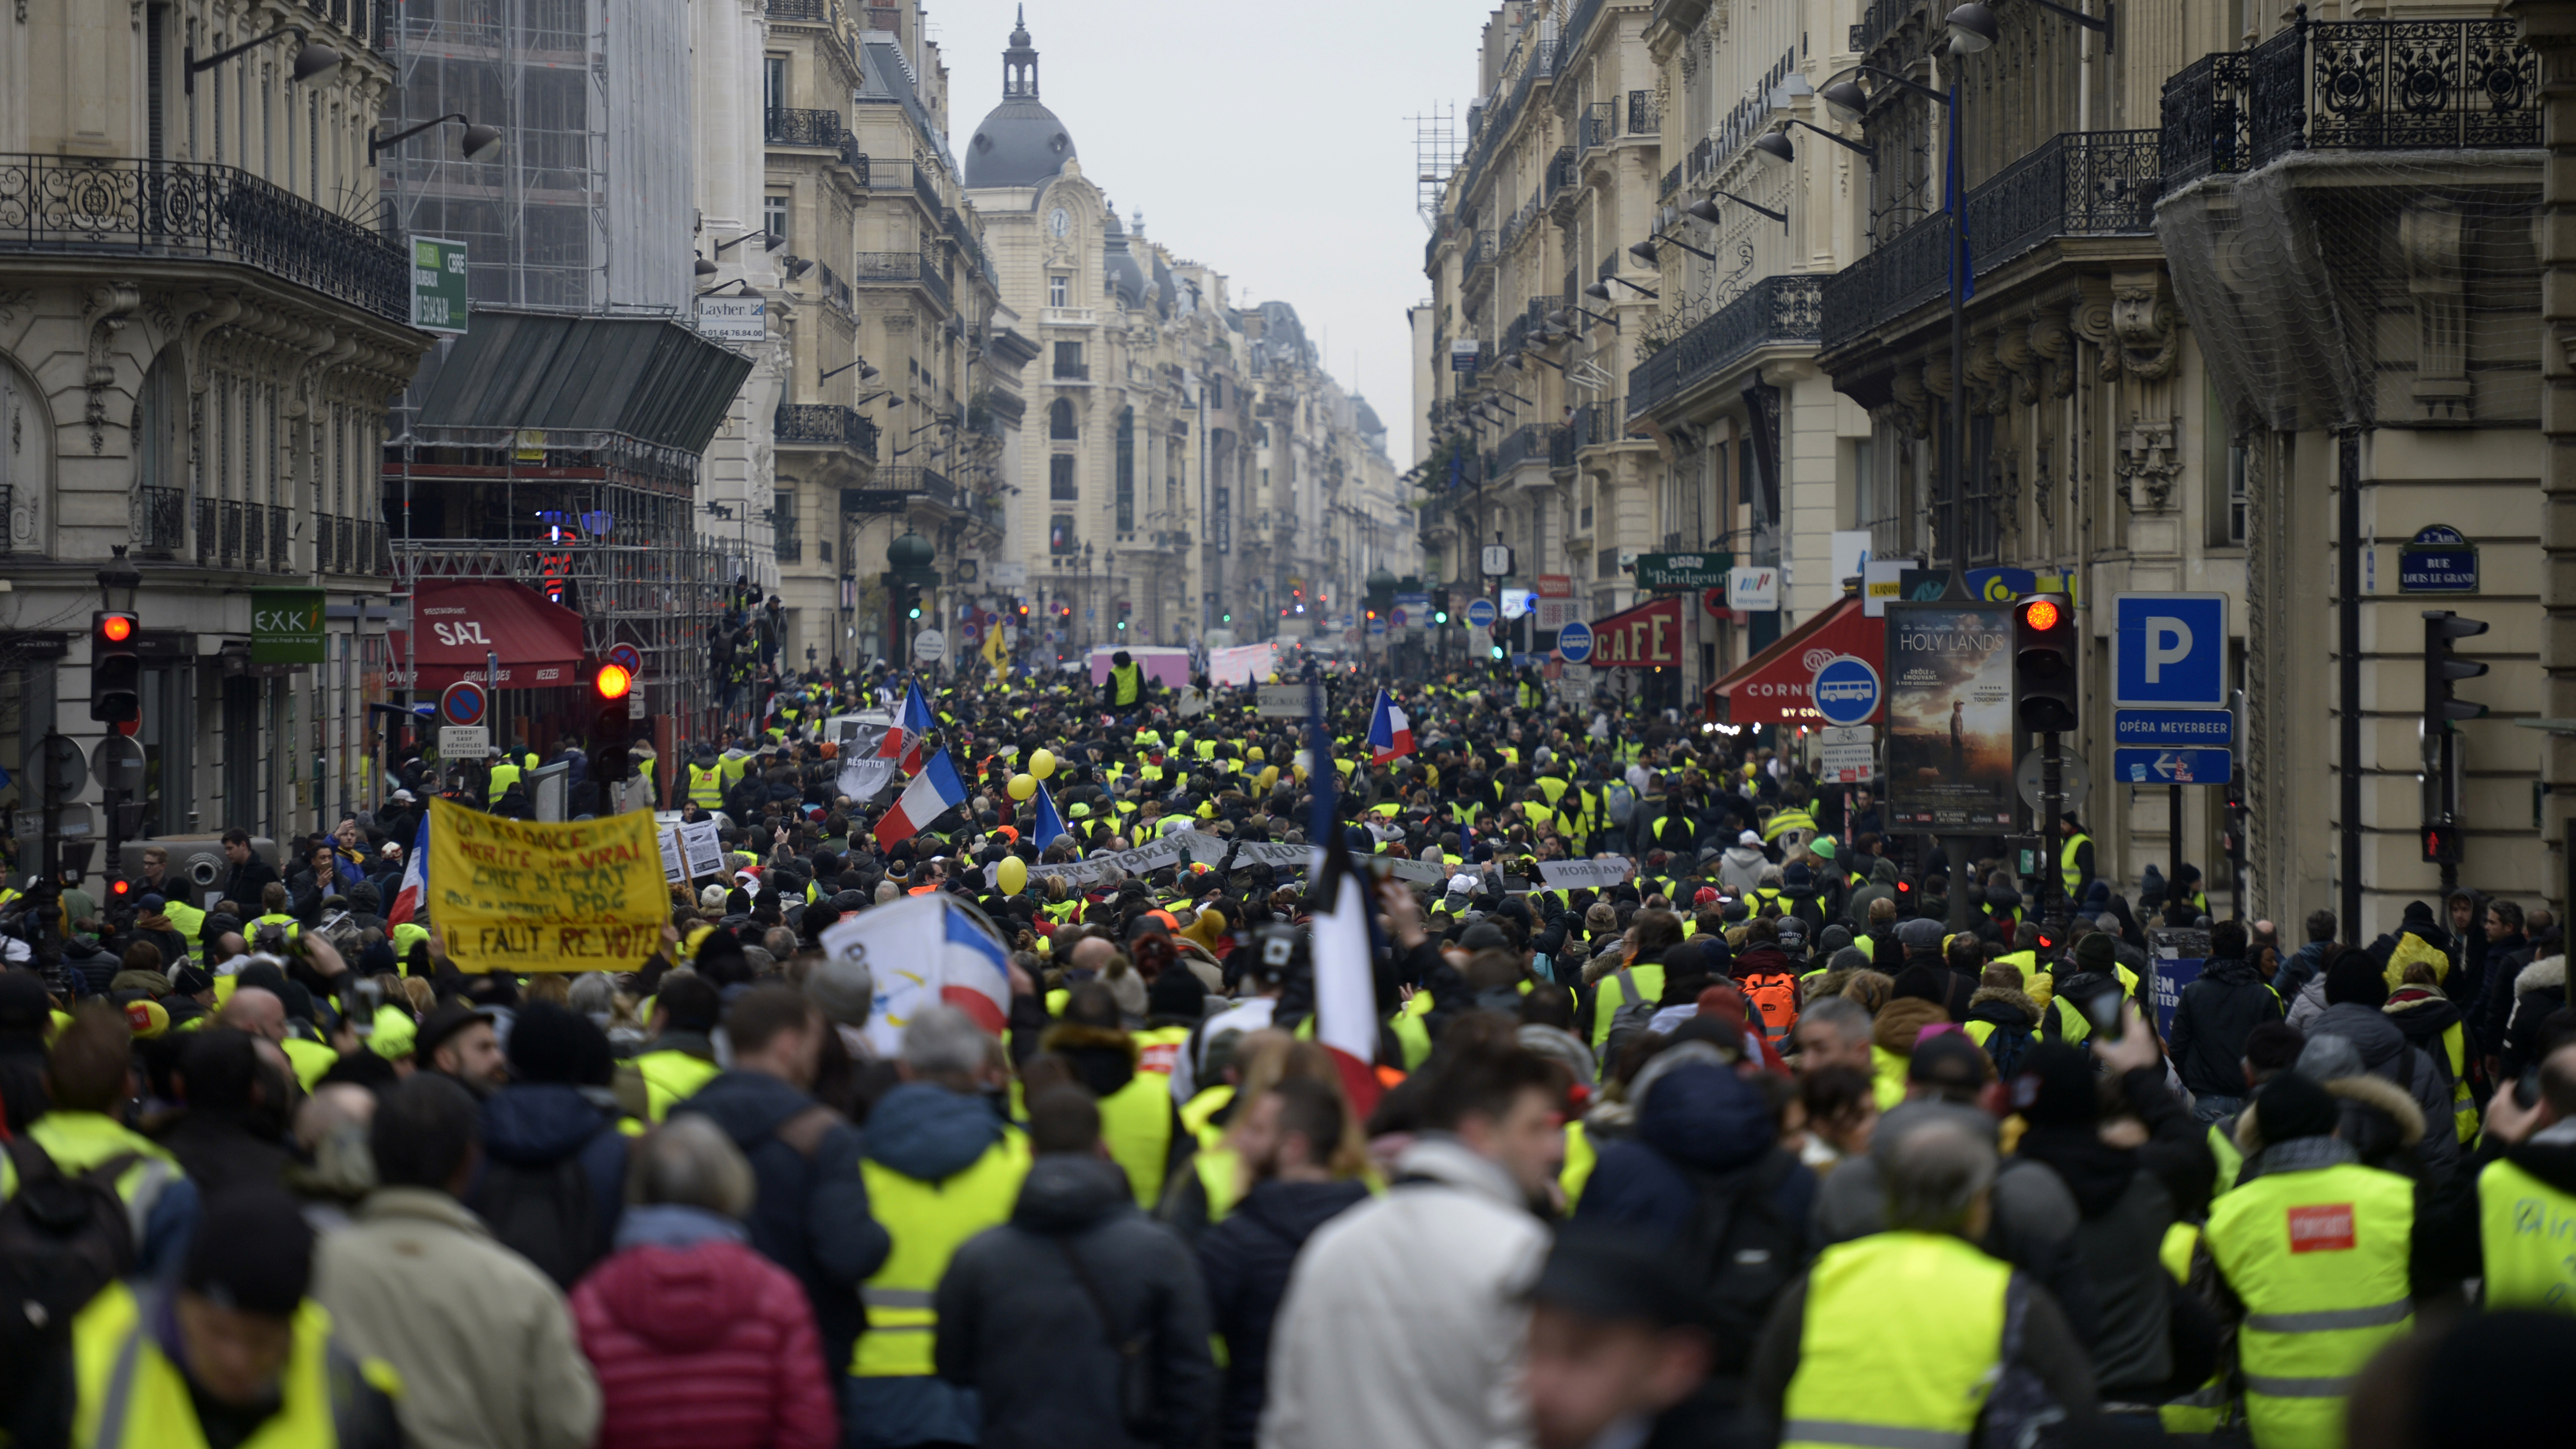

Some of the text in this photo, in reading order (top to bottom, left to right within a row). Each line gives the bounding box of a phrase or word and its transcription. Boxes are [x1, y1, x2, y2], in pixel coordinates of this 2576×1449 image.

[447, 252, 465, 274] CBRE
[417, 269, 438, 288] BUREAUX
[417, 294, 422, 321] 01
[700, 303, 744, 317] Layher
[2426, 558, 2451, 569] RUE
[1655, 569, 1726, 588] Bridgeur
[2403, 573, 2476, 583] LOUIS LE GRAND
[1875, 584, 1901, 595] LIQUO
[1736, 597, 1772, 606] Manpower
[433, 622, 491, 646] SAZ
[1901, 634, 2004, 651] HOLY LANDS
[2145, 616, 2193, 683] P
[463, 670, 511, 682] GRILLDES
[536, 669, 559, 680] MEZZES
[1746, 683, 1812, 697] CORNE
[1781, 708, 1797, 717] BY
[2120, 719, 2227, 733] OPÉRA MEYERBEER
[572, 890, 625, 915] PDG
[479, 926, 543, 956] FAUT
